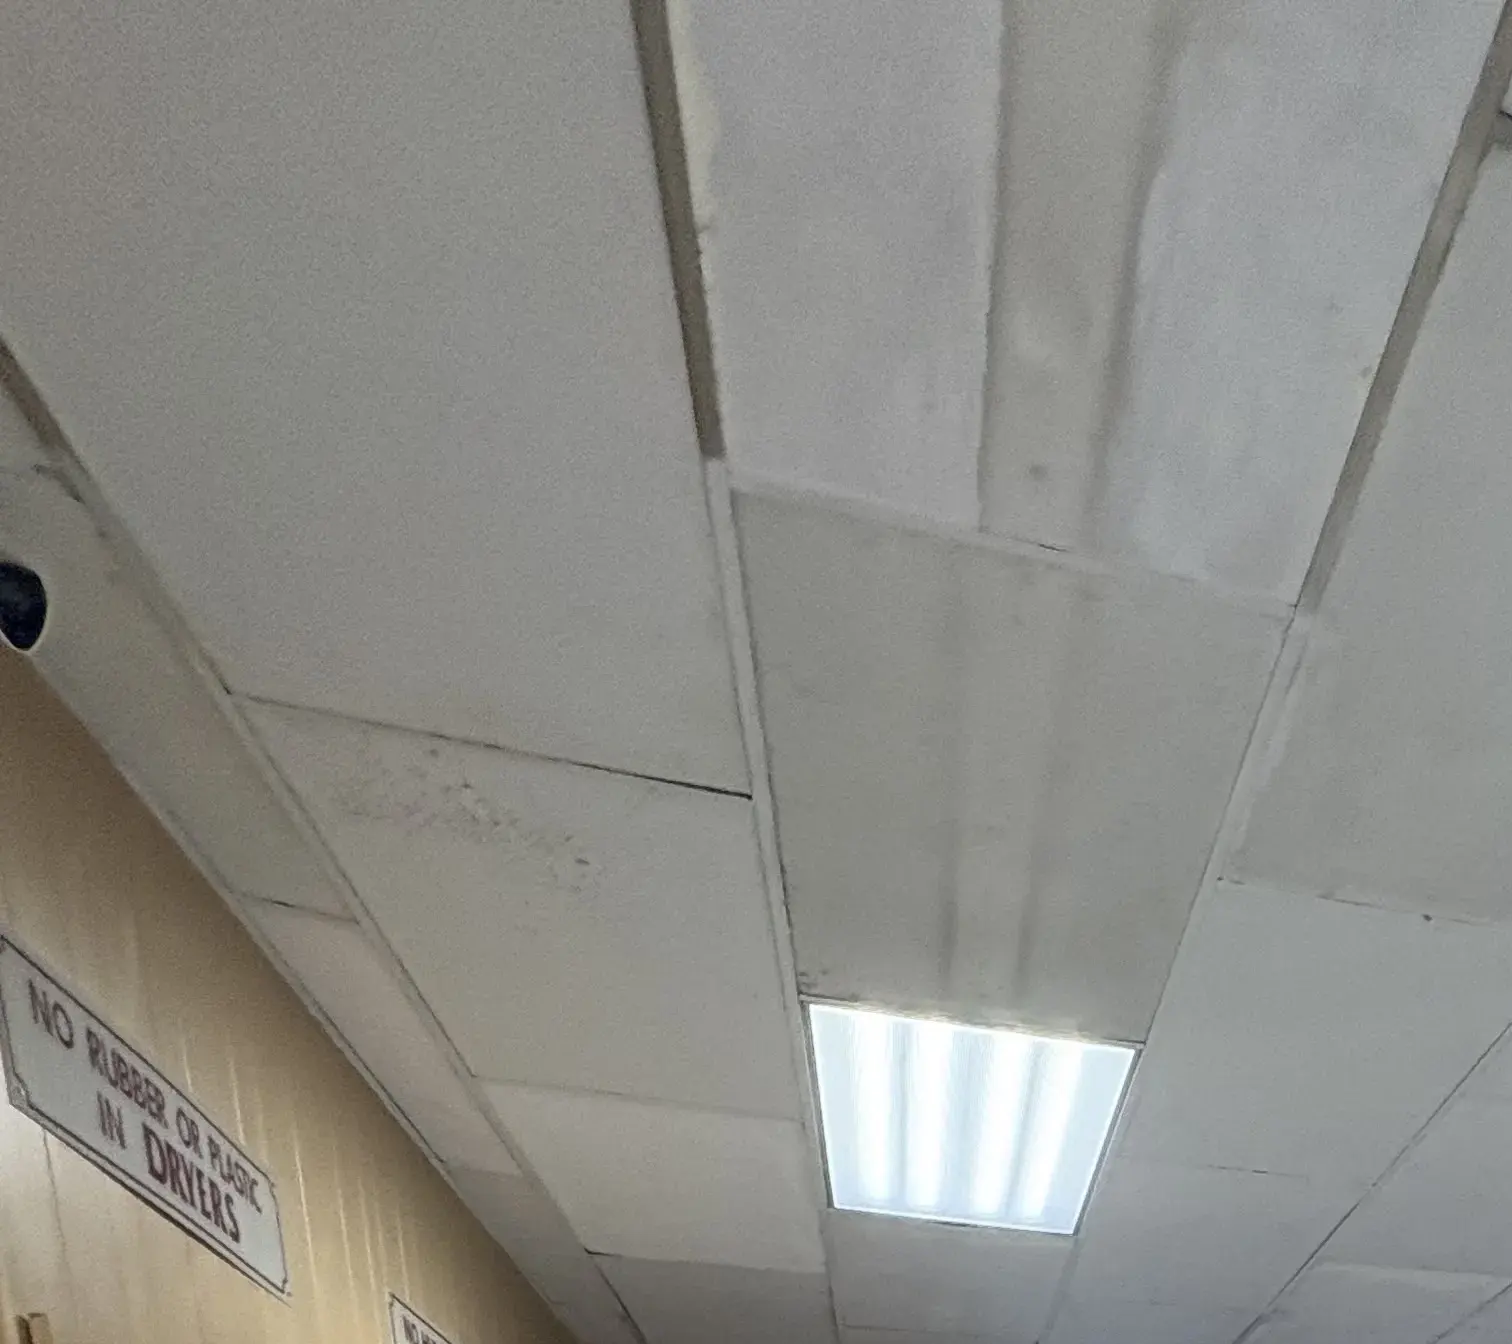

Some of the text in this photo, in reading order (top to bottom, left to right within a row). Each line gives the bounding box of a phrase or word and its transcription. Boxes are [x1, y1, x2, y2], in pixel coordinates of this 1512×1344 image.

[28, 979, 262, 1214] NO RUBBER OR PLASTIC
[97, 1092, 240, 1243] IN DRYERS
